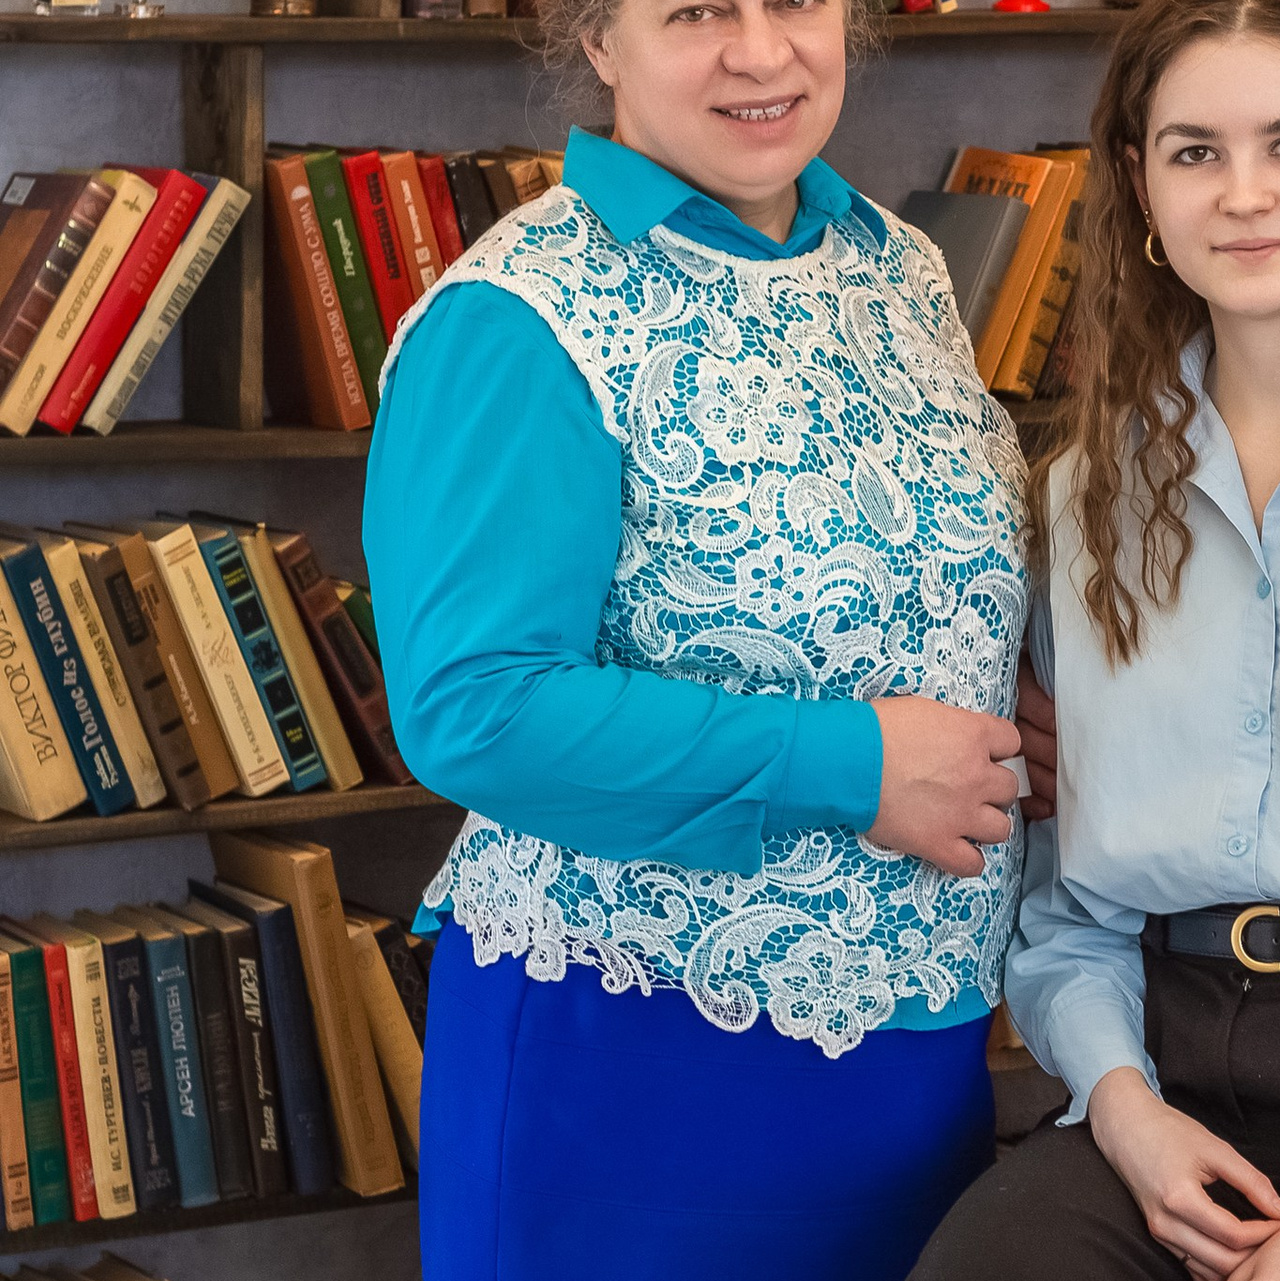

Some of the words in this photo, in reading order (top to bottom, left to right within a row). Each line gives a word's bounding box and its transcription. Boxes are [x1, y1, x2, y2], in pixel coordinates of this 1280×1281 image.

[296, 201, 317, 235] УМА
[54, 243, 114, 341] ВОСКРЕСЕНИЕ
[309, 249, 336, 307] СОШЛО
[325, 309, 349, 357] ВРЕМЯ
[338, 358, 362, 405] КОГДА
[25, 575, 70, 658] глубин
[59, 656, 79, 688] из
[3, 660, 59, 765] ВИКТОР
[67, 685, 104, 751] Голос
[90, 996, 108, 1065] ПОВЕСТИ
[164, 984, 186, 1052] ЛЮПЕН
[99, 1074, 119, 1144] ТУРГЕНЕВ
[173, 1057, 195, 1119] АРСЕН
